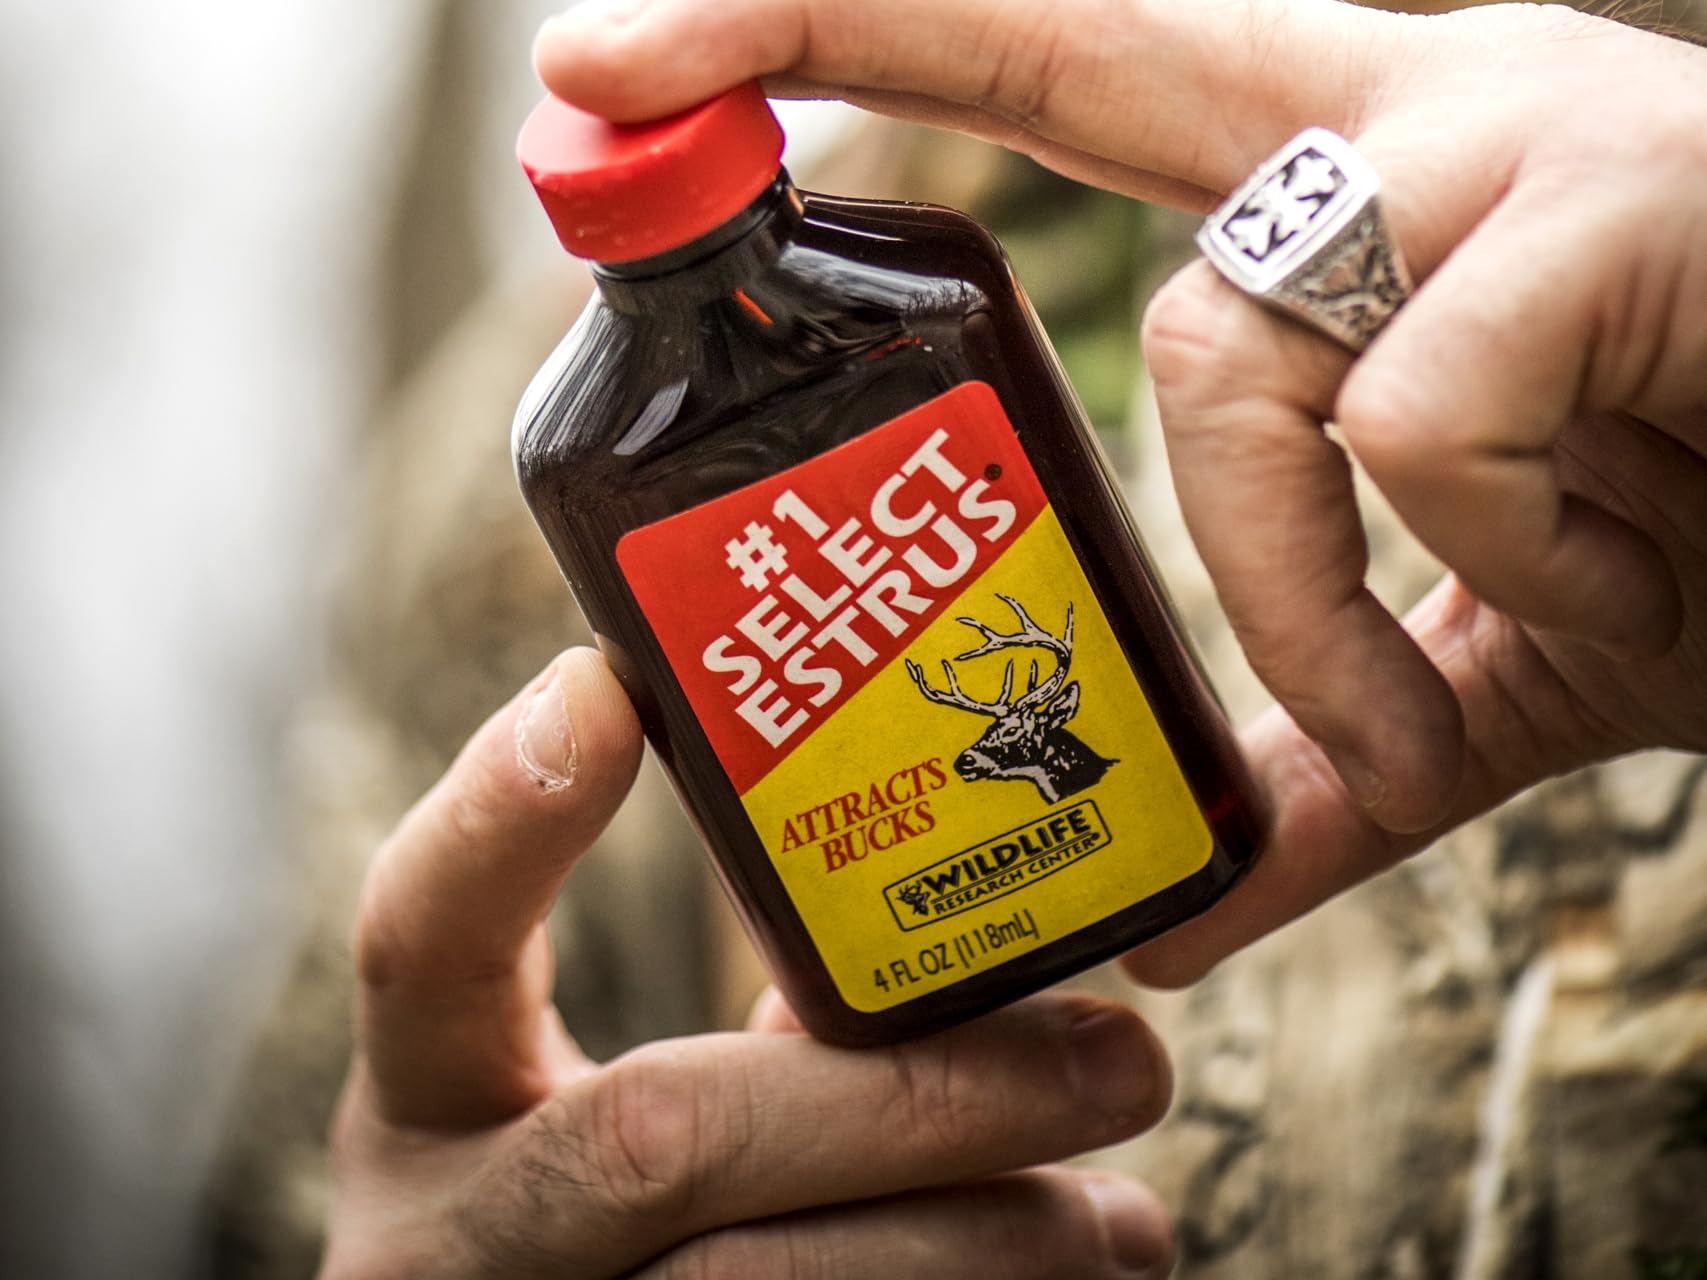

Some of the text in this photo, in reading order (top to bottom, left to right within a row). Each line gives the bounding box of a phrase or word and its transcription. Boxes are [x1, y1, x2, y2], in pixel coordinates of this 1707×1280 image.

[702, 428, 967, 696] SELECT
[725, 489, 830, 592] #1
[780, 757, 948, 854] ATTRACTS
[819, 801, 936, 873] BUCKS
[920, 808, 1092, 896] WILDLIFE
[933, 871, 1025, 915] RESEARCH
[873, 909, 1040, 993] 4 FL OZ (118mL)
